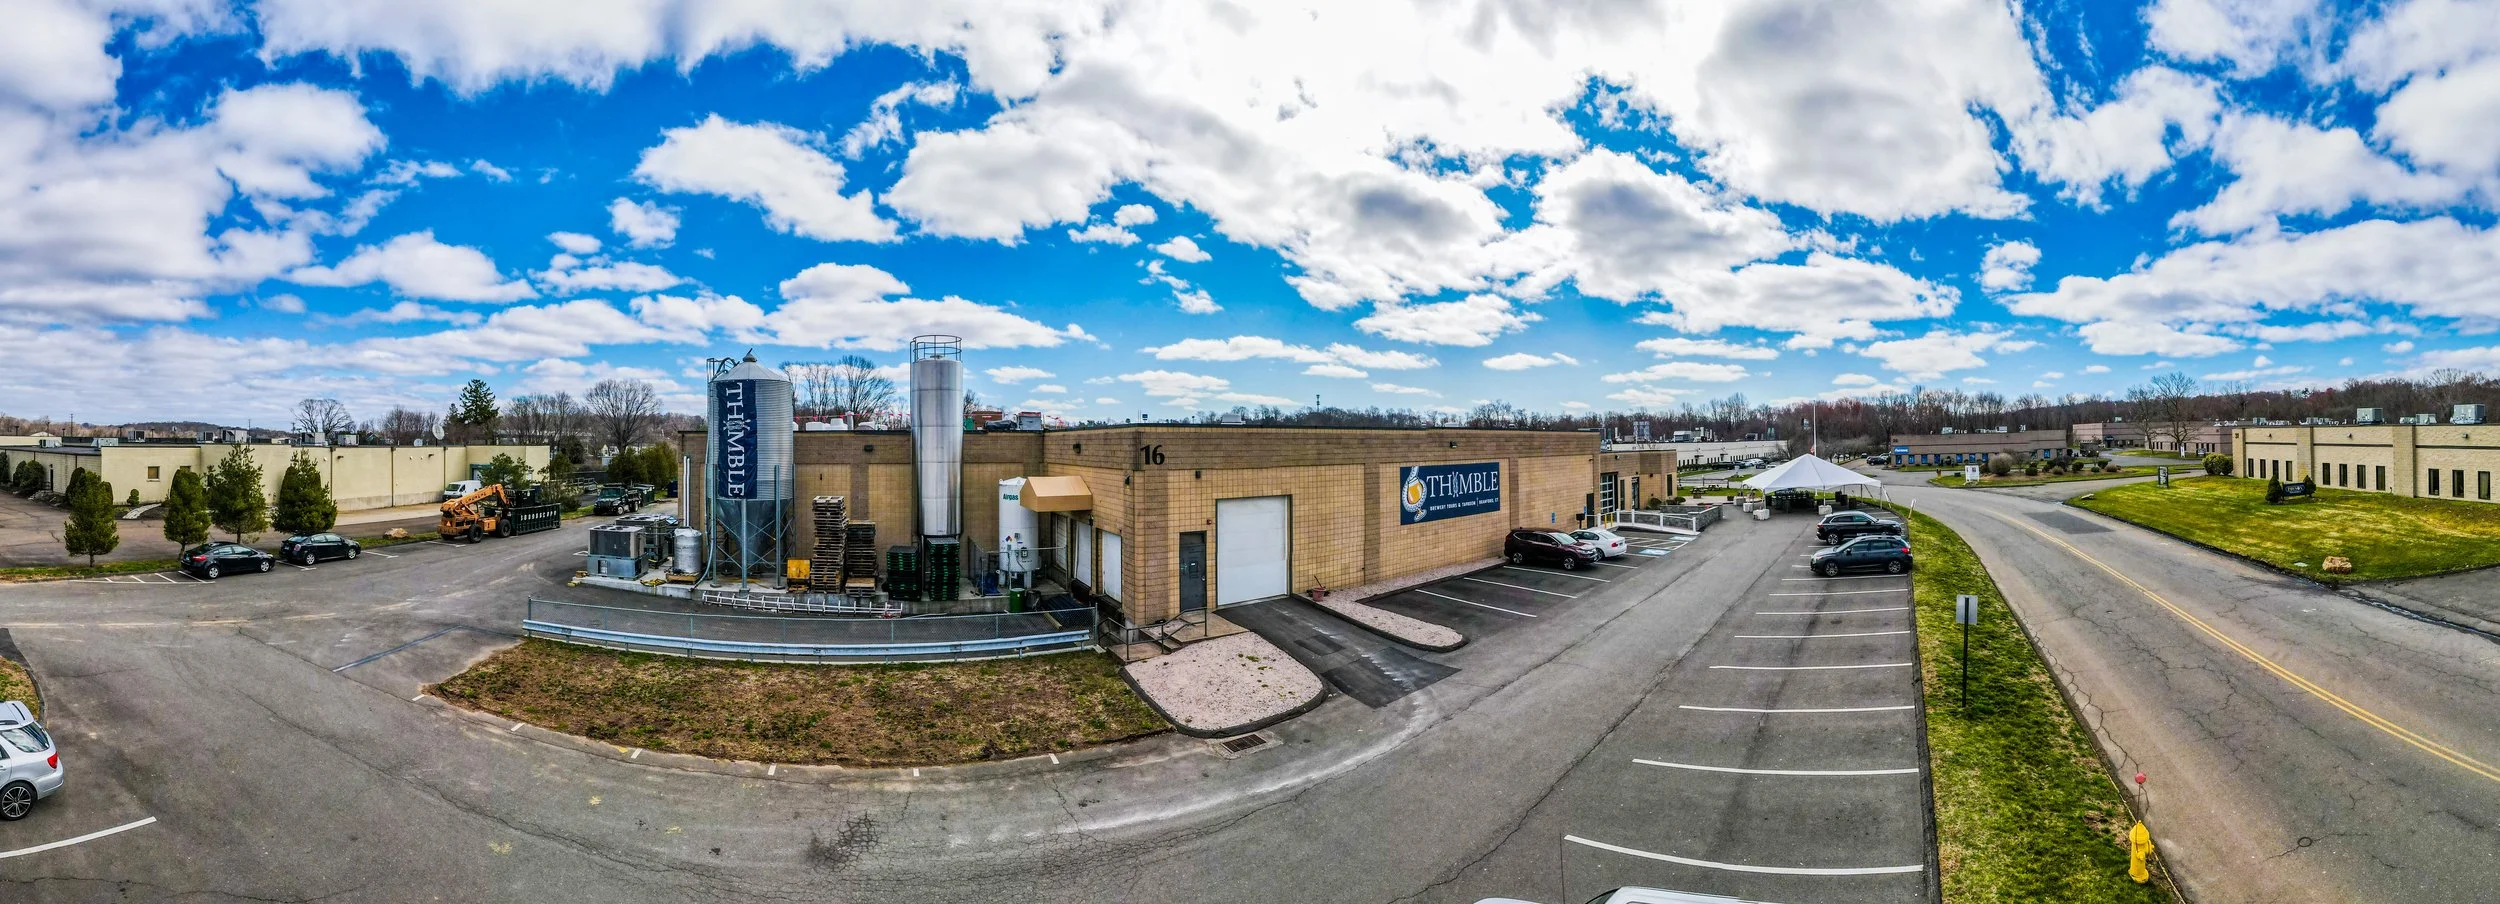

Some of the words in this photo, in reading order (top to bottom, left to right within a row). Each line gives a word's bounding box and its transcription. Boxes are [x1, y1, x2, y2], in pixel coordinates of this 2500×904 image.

[724, 382, 748, 497] THIMBLE
[1140, 444, 1165, 465] 16
[1426, 471, 1498, 498] THIMBLE
